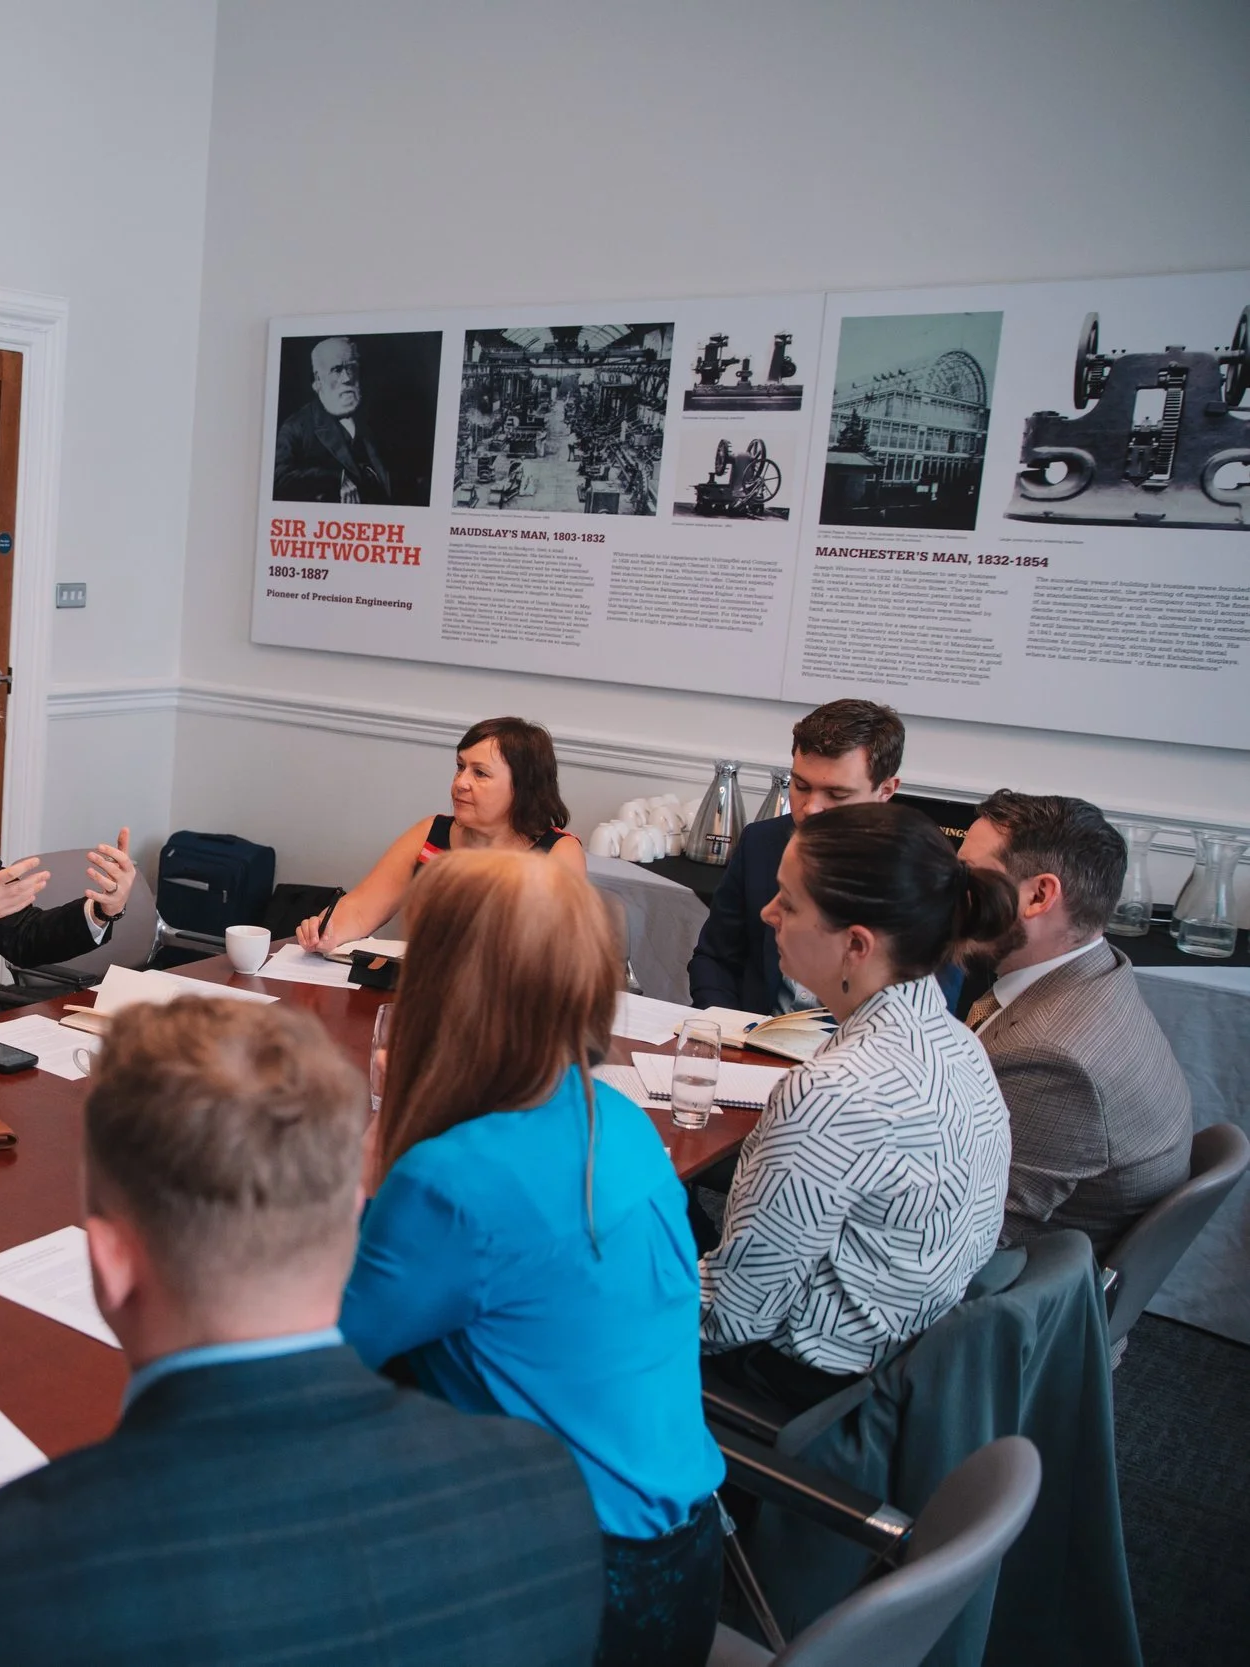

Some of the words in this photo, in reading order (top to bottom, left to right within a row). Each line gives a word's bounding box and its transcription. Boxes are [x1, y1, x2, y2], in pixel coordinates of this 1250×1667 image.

[270, 519, 306, 538] SIR
[313, 521, 405, 543] JOSEPH
[450, 527, 518, 538] MAUDSLAY'S
[520, 530, 550, 541] MAN,
[553, 532, 605, 543] 1803-1832
[270, 539, 421, 565] WHITWORTH
[815, 546, 929, 562] MANCHESTER'S
[932, 552, 972, 565] MAN,
[977, 554, 1049, 568] 1832-1854
[269, 566, 329, 580] 1803-1887
[267, 589, 299, 599] Pioneer
[301, 592, 309, 600] of
[312, 593, 352, 603] Precision
[355, 597, 412, 610] Engineering
